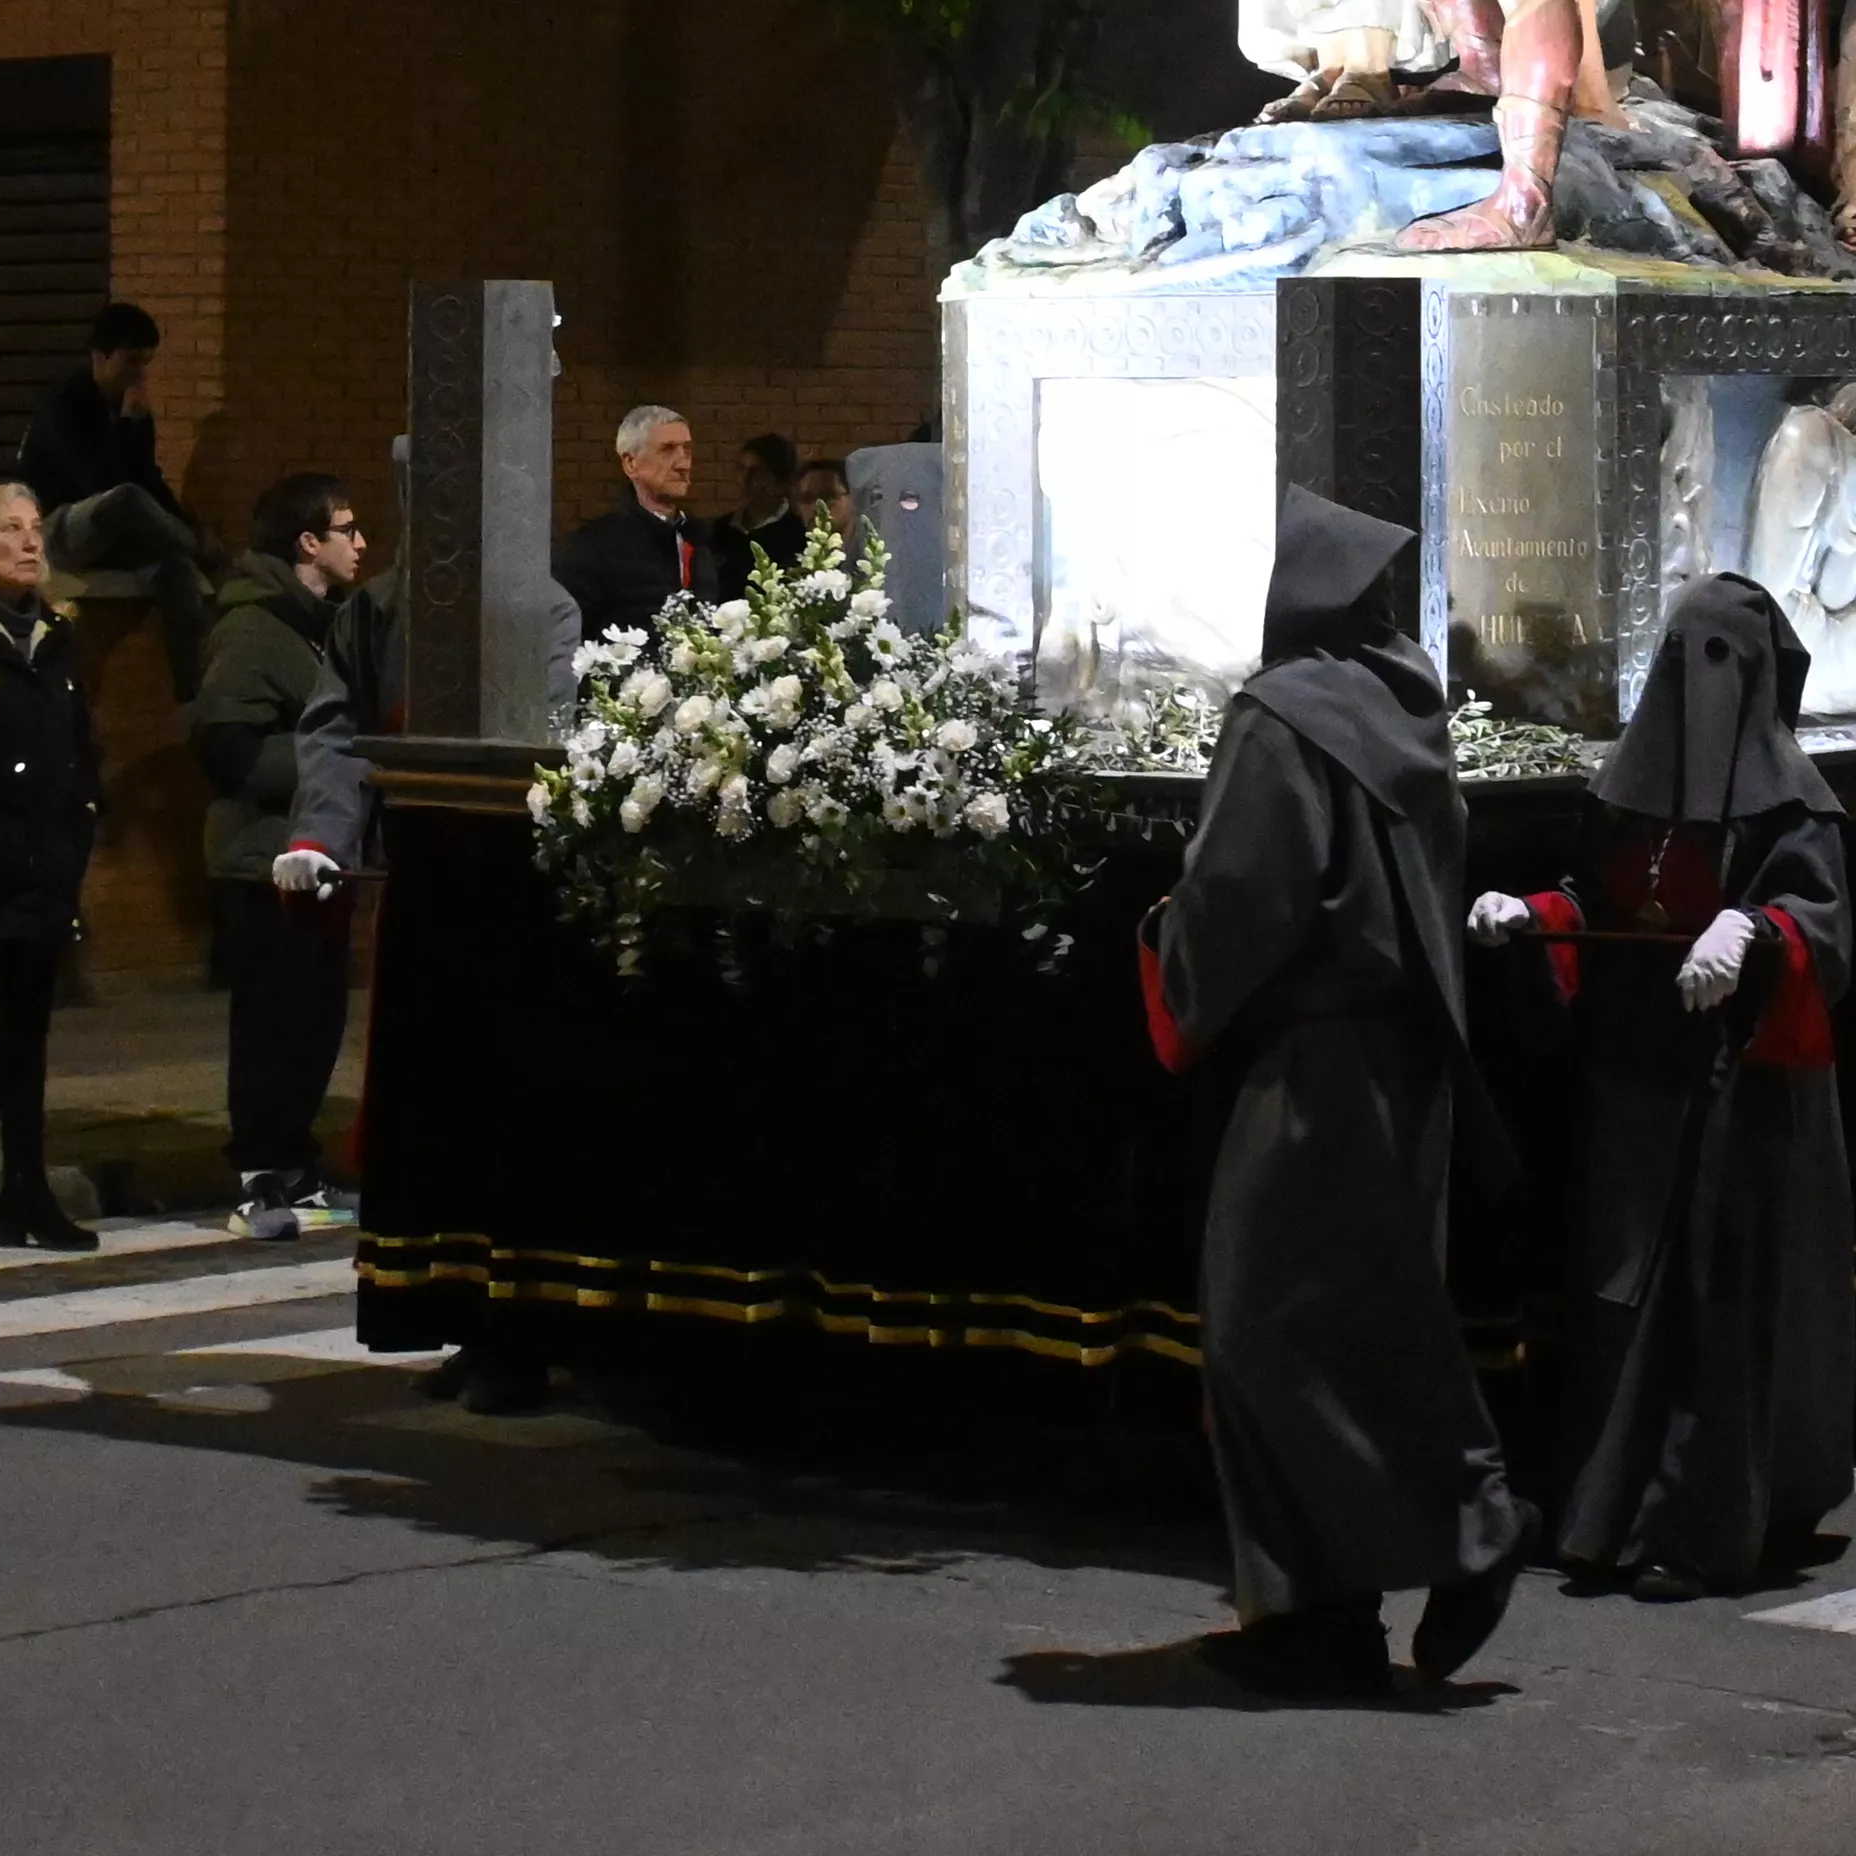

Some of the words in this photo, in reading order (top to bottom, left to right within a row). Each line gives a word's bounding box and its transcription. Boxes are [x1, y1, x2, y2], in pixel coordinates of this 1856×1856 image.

[1499, 440, 1537, 463] por
[1546, 436, 1562, 458] el
[1505, 571, 1528, 593] de
